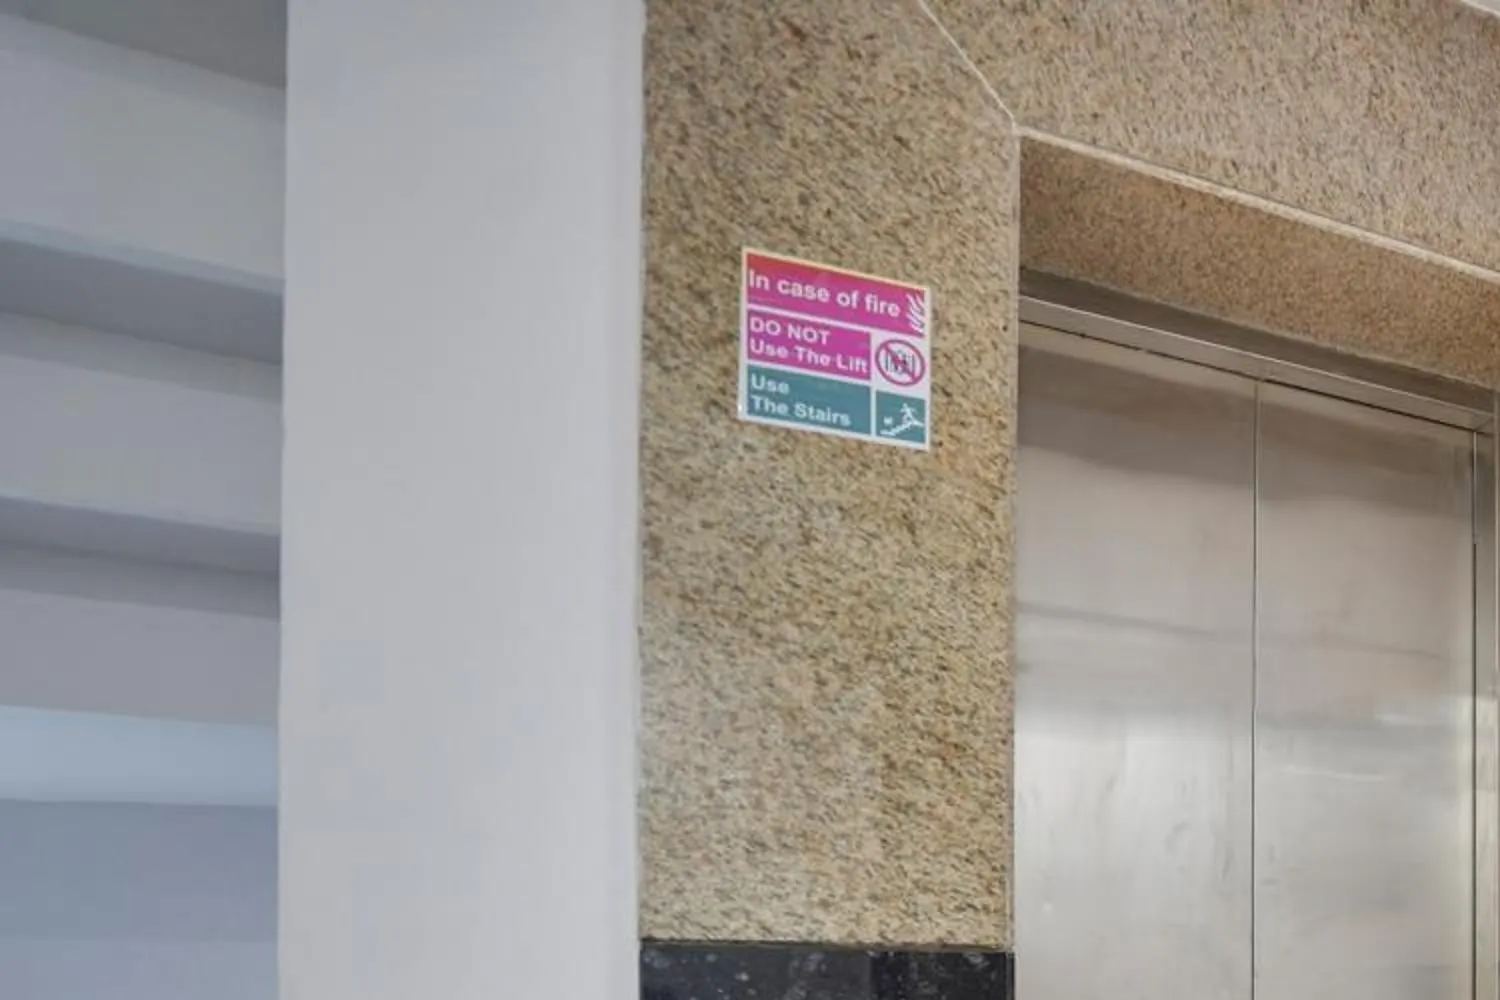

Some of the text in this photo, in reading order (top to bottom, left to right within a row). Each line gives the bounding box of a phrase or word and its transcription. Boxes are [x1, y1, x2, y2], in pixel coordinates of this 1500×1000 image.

[749, 269, 901, 318] In case of fire
[750, 317, 831, 345] DO NOT
[750, 337, 868, 374] Use The Lift
[751, 374, 790, 395] Use
[751, 395, 851, 427] The Stairs
